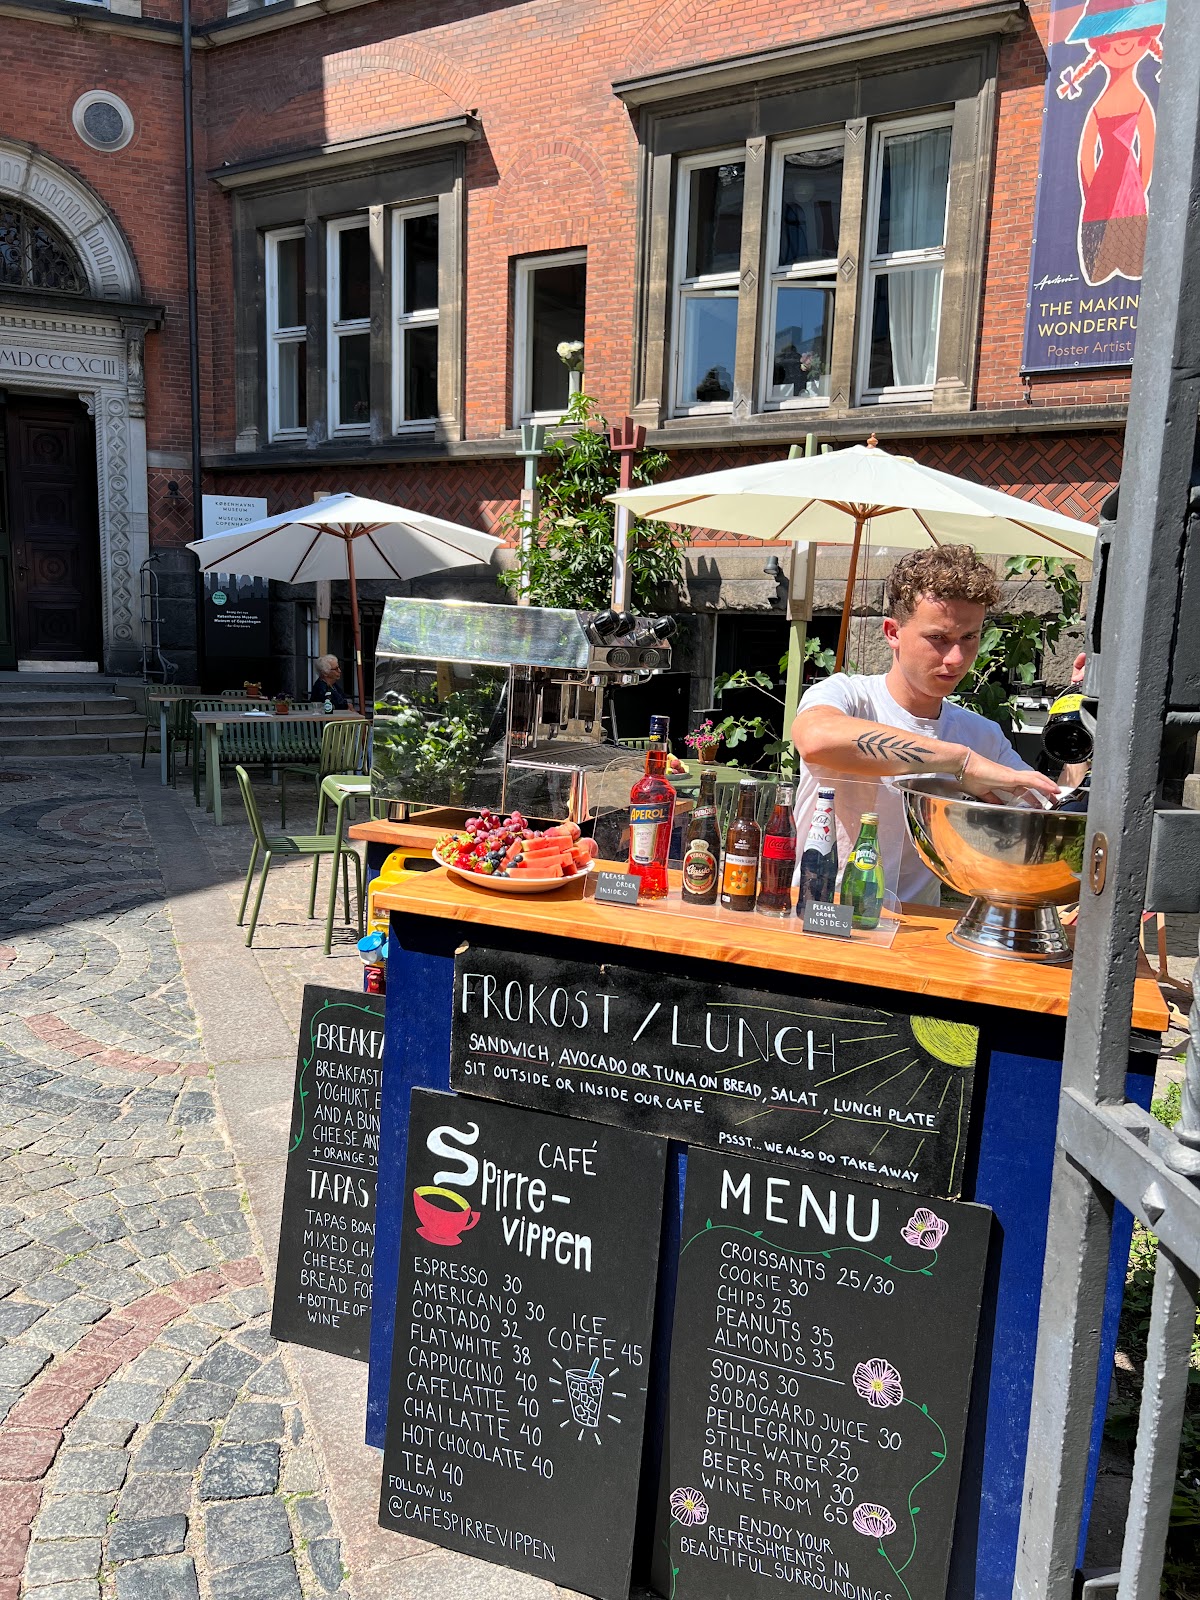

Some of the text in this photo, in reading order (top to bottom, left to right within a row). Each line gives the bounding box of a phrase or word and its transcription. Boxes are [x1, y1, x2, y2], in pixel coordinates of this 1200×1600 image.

[1040, 294, 1141, 317] THE MAKIN
[1047, 340, 1132, 357] Poster Artist
[630, 808, 664, 821] APEROL
[600, 887, 622, 896] INSIDE
[601, 872, 625, 880] PLEASE
[615, 881, 636, 890] ORDER
[809, 917, 842, 928] INSIDE
[812, 903, 835, 912] PLEASE
[815, 911, 837, 919] ORDER
[462, 973, 619, 1033] FROKOST
[672, 1005, 835, 1073] LUNCH
[464, 1060, 704, 1113] SIT OUTSIDE OR INSIDE OUR CAFÉ
[558, 1048, 627, 1074] AVOCADO
[631, 1062, 651, 1078] OR
[653, 1064, 696, 1087] TUNA
[700, 1075, 718, 1089] ON
[833, 1097, 882, 1118] LUNCH
[888, 1108, 935, 1127] PLATE
[314, 1103, 342, 1124] AND
[344, 1109, 354, 1127] A
[312, 1124, 360, 1147] CHEESE
[323, 1147, 365, 1163] ORANGE
[538, 1140, 597, 1176] CAFÉ
[764, 1141, 783, 1154] WE
[786, 1147, 814, 1160] ALSO
[818, 1151, 835, 1163] DO
[840, 1155, 876, 1172] TAKE
[878, 1164, 919, 1183] AWAY
[306, 1169, 369, 1208] TAPAS
[720, 1169, 880, 1242] MENU
[304, 1208, 348, 1231] TAPAS
[303, 1229, 349, 1253] MIXED
[502, 1215, 592, 1272] vippen
[300, 1269, 348, 1294] BREAD
[414, 1257, 522, 1294] ESPRESSO 30
[719, 1263, 809, 1296] COOKIE 30
[720, 1241, 895, 1295] CROISSANTS 25/30
[307, 1310, 341, 1328] WINE
[412, 1300, 522, 1339] CORTADO 32
[413, 1280, 545, 1321] AMERICANO 30
[717, 1284, 792, 1317] CHIPS 25
[573, 1312, 607, 1334] ICE
[716, 1305, 834, 1348] PEANUTS 35
[411, 1323, 531, 1365] FLAT WHITE 38
[548, 1327, 643, 1366] COFFE 45
[714, 1327, 835, 1371] ALMONDS 35
[408, 1346, 537, 1391] CAPPUCCINO 40
[710, 1358, 799, 1397] SODAS 30
[407, 1372, 539, 1418] CAFE LATTE 40
[404, 1397, 542, 1447] CHAI LATTE 40
[706, 1406, 851, 1461] PELLEGRINO 25
[709, 1383, 901, 1450] SOBOGAARD JUICE 30
[402, 1422, 554, 1479] HOT CHOCOLATE 40
[402, 1451, 463, 1486] TEA 40
[705, 1428, 859, 1483] STILL WATER 20
[389, 1475, 435, 1498] FOLLOW
[703, 1448, 854, 1506] BEERS FROM 30
[701, 1472, 848, 1525] WINE FROM 65
[388, 1495, 556, 1562] @CAFESPIRREVIPPEN
[739, 1514, 834, 1555] ENJOY YOUR
[680, 1536, 772, 1578] BEAUTIFUL
[708, 1525, 850, 1579] REFRESHMENTS IN
